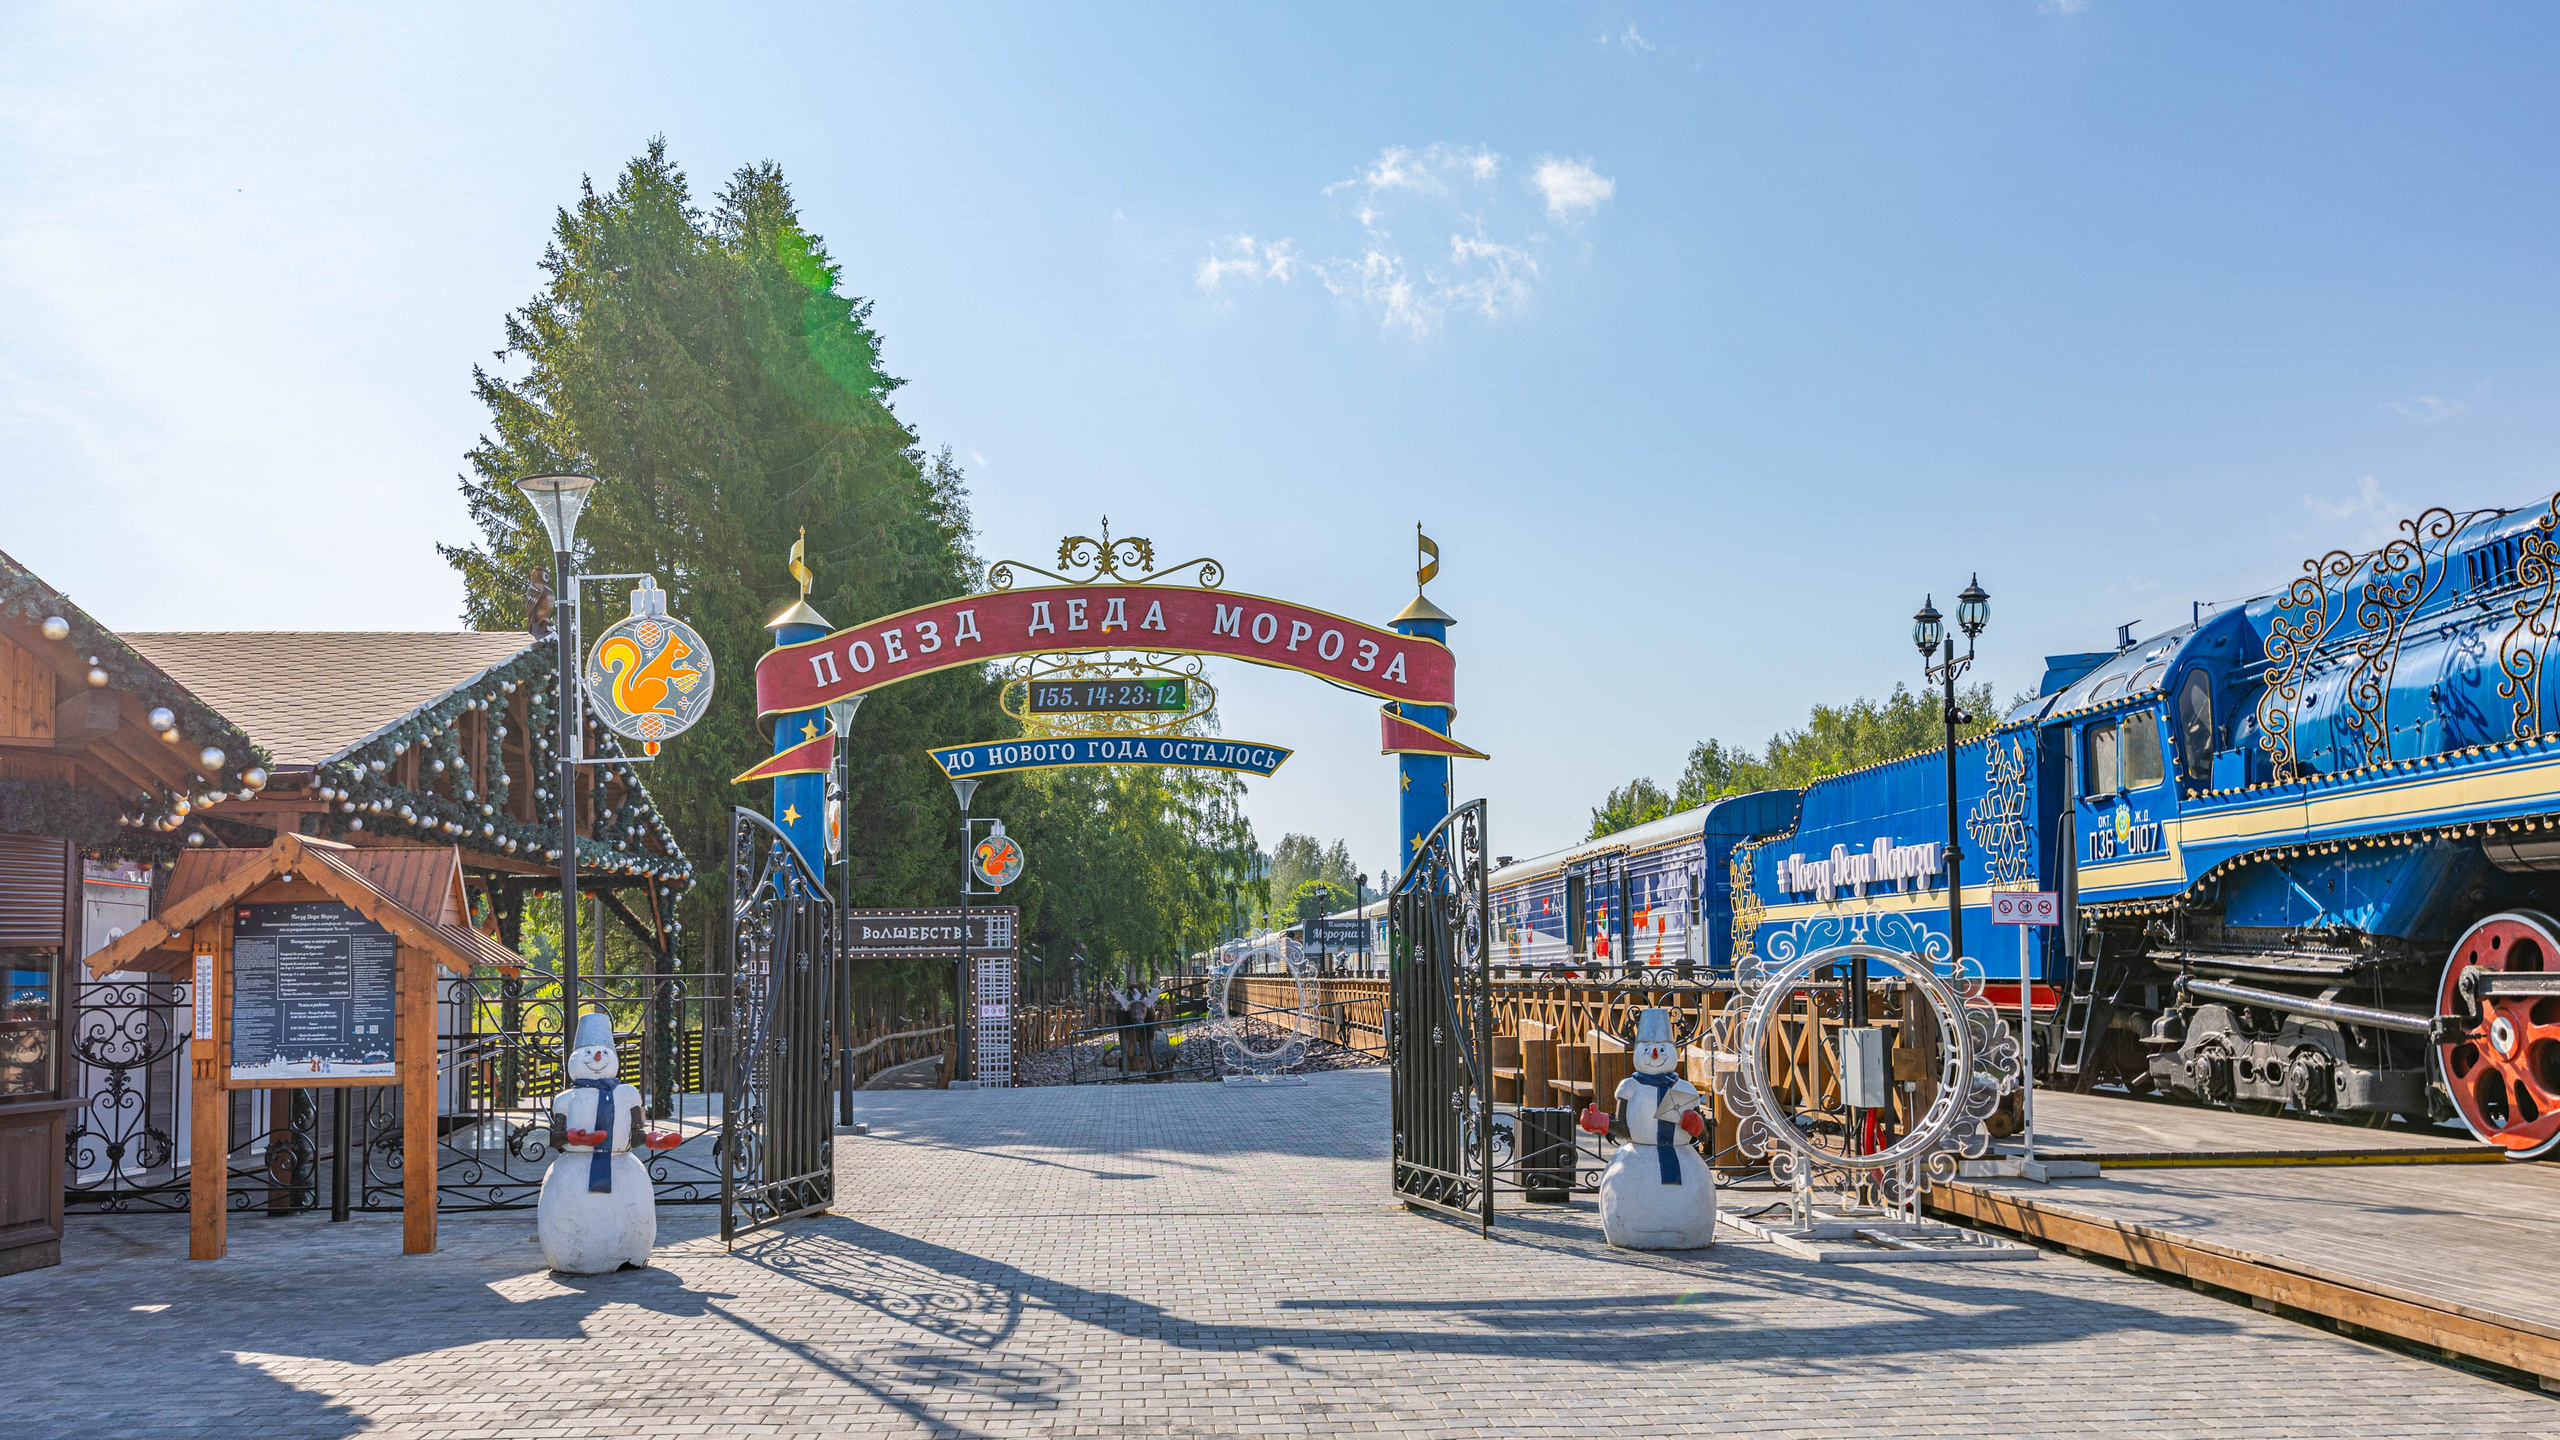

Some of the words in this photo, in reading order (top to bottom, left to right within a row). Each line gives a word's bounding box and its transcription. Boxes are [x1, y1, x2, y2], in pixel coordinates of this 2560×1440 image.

[809, 609, 982, 688] ПОЕЗД
[1028, 598, 1166, 637] ДЕДА
[1212, 603, 1407, 684] МОРОЗА
[946, 751, 975, 772] ДО
[988, 742, 1075, 766] НОВОГО
[1088, 741, 1148, 760] ГОДА
[1160, 743, 1277, 769] ОСТАЛОСЬ
[2098, 814, 2112, 828] ОКТ.
[2134, 809, 2151, 823] Ж.Д.
[2089, 828, 2114, 861] П36
[2128, 822, 2158, 855] 0107
